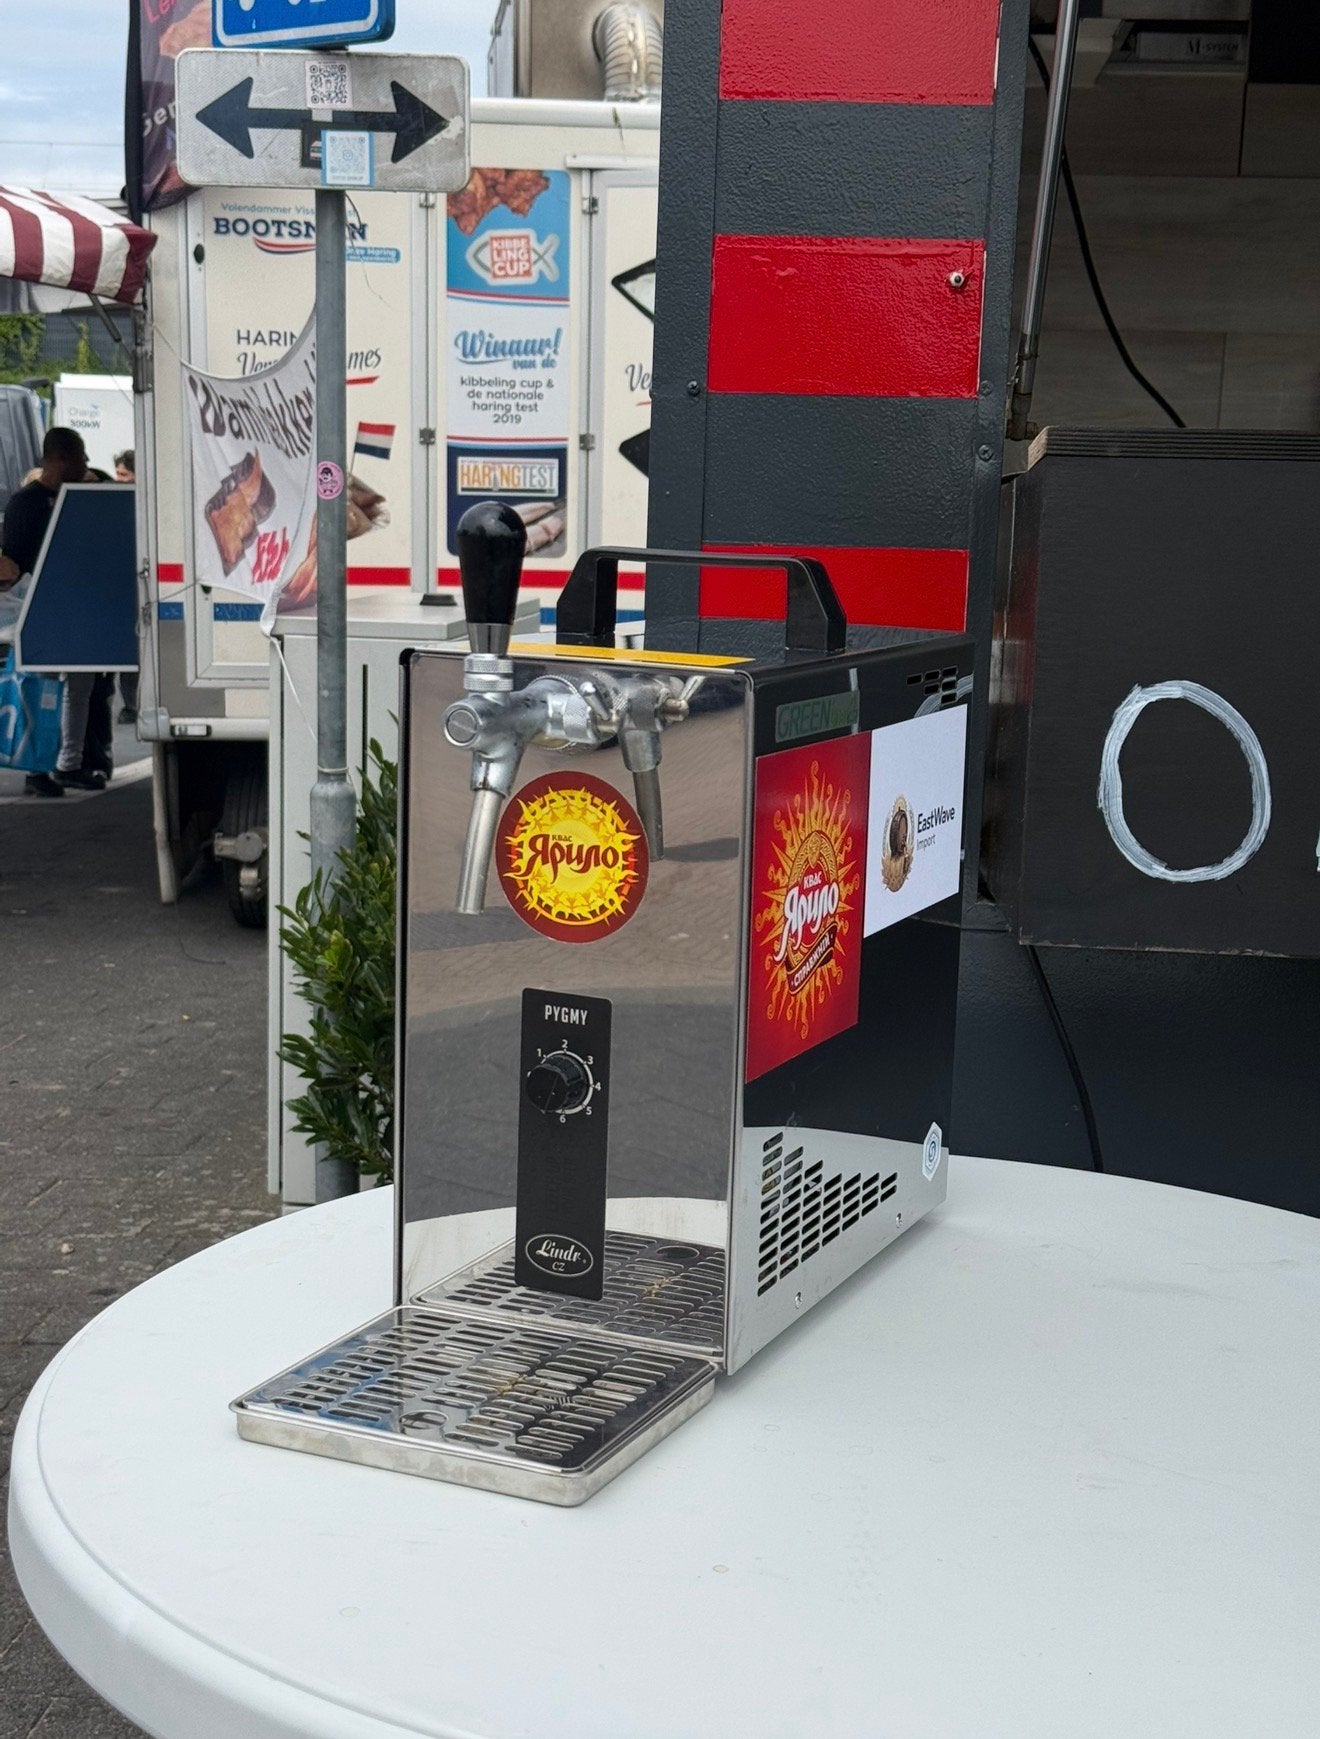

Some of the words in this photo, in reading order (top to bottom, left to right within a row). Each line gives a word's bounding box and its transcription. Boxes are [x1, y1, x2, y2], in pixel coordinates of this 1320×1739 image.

[221, 203, 292, 215] Volendammer
[213, 217, 368, 241] BOOTSN
[492, 237, 528, 250] KIBBE
[493, 250, 529, 262] LING
[493, 262, 531, 276] CUP
[454, 328, 563, 360] Winaar!
[512, 358, 537, 369] van
[541, 354, 557, 369] de
[461, 377, 516, 390] kibbeling
[520, 379, 543, 391] cup
[546, 379, 554, 388] &
[467, 389, 483, 399] de
[487, 389, 544, 400] nationale
[472, 401, 512, 413] haring
[516, 402, 538, 412] test
[493, 413, 522, 424] 2019
[1098, 680, 1320, 883] O
[917, 806, 956, 834] EastWave
[916, 834, 936, 852] Import
[514, 833, 620, 885] Ярило
[773, 881, 840, 962] Ярило
[544, 1004, 588, 1026] PYGMY
[561, 1039, 568, 1049] 2
[536, 1048, 542, 1058] 1
[587, 1055, 594, 1065] 3
[594, 1081, 602, 1092] 4
[586, 1106, 592, 1116] 5
[559, 1114, 566, 1124] 6
[535, 1239, 582, 1263] Lindr
[551, 1261, 566, 1272] CZ
